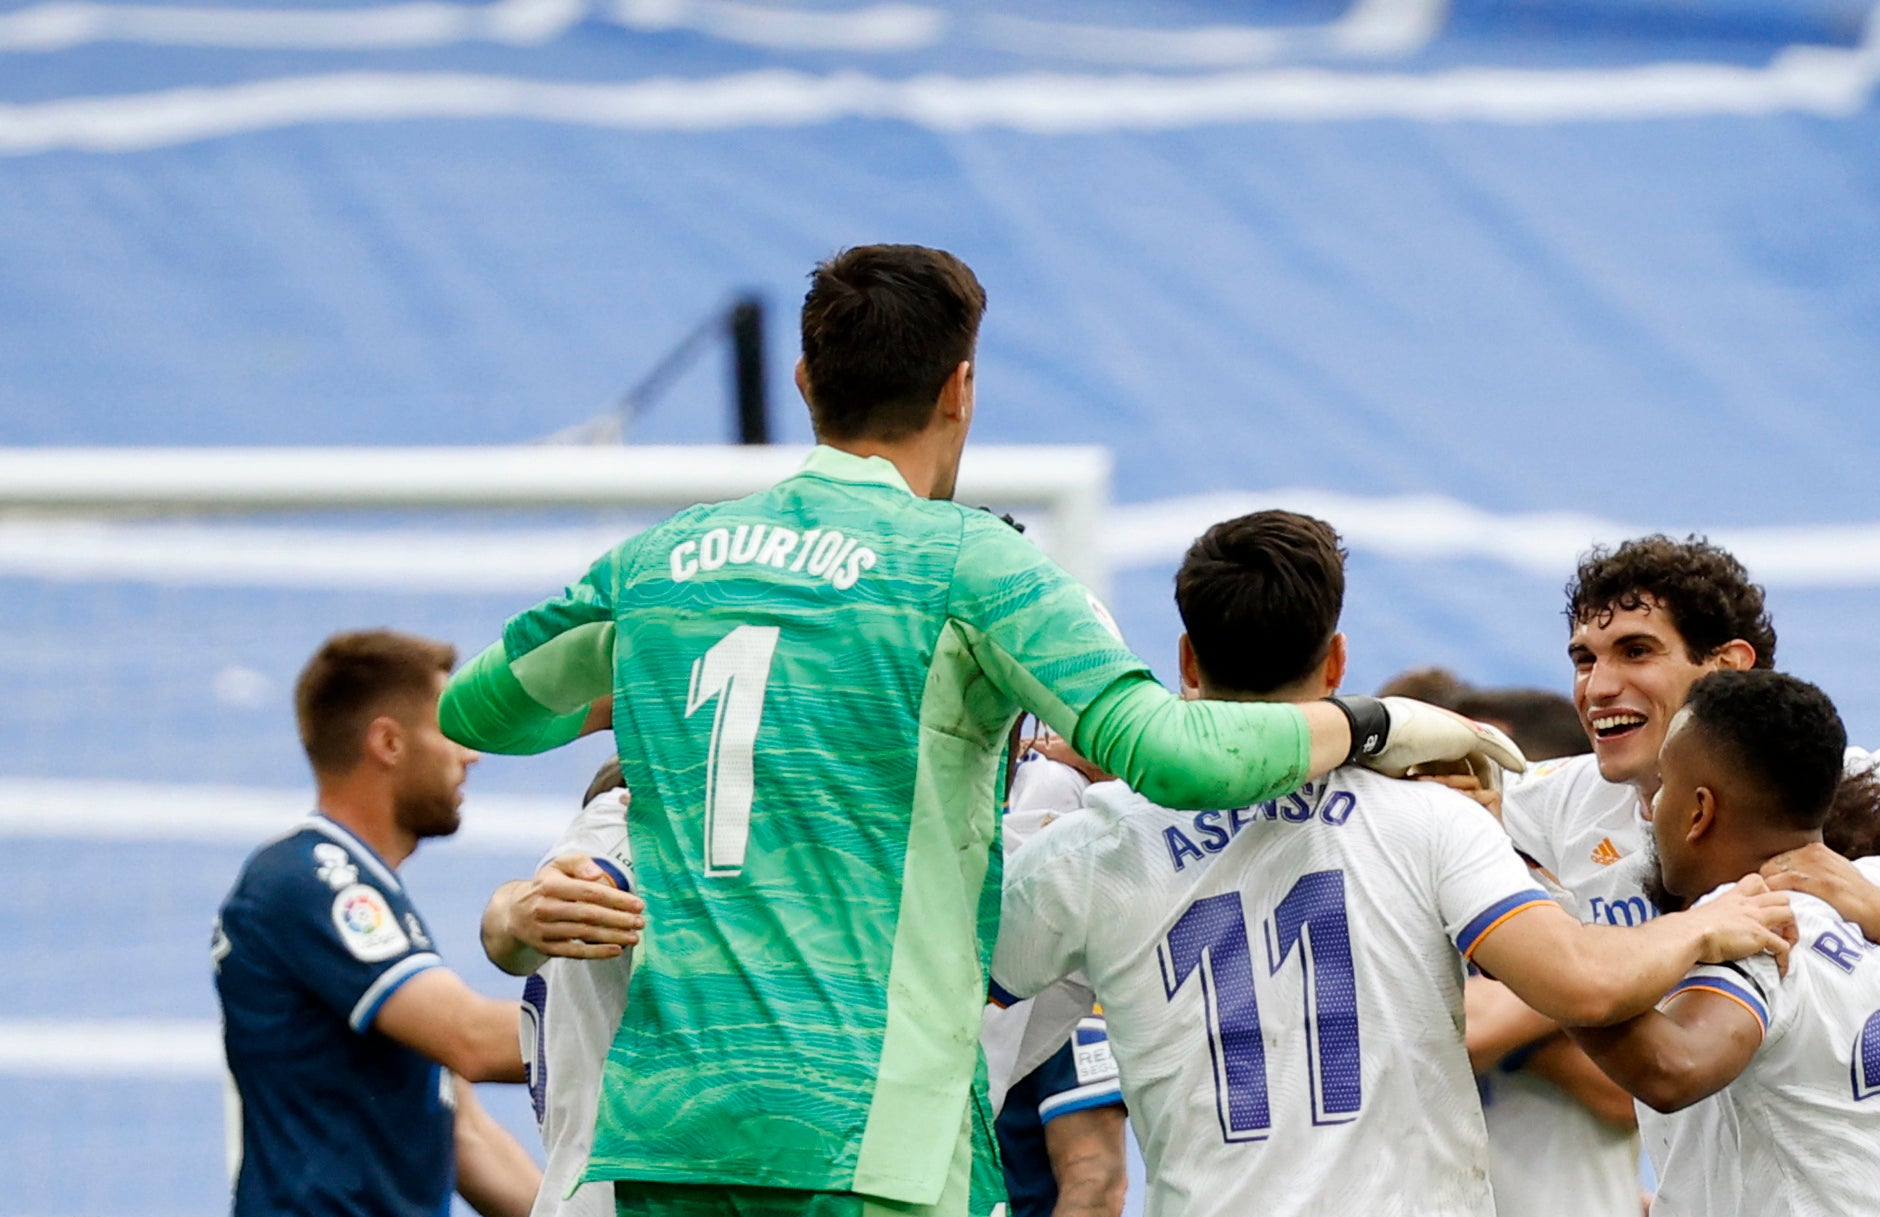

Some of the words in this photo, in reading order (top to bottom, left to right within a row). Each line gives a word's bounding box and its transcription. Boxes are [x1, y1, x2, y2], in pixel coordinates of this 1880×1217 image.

[669, 524, 877, 591] COURTOIS
[685, 625, 780, 878] 1
[1162, 781, 1357, 872] ASENSO
[1157, 869, 1362, 1143] 11
